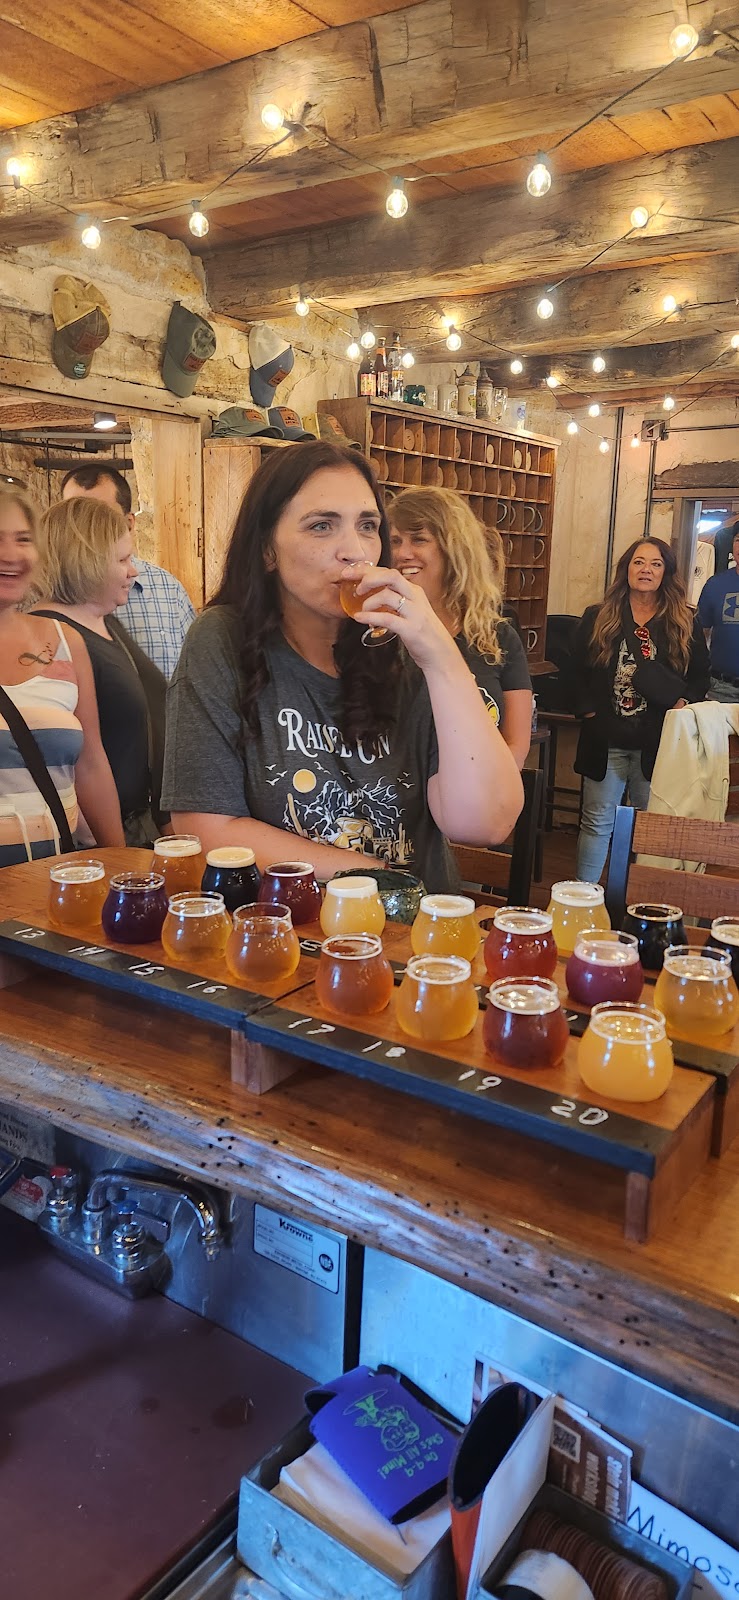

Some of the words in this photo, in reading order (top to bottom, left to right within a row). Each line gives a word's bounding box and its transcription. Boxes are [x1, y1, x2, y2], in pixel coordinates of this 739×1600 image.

[14, 927, 46, 939] 13
[68, 946, 106, 957] 14
[127, 961, 165, 976] 15
[186, 980, 228, 994] 16
[288, 1017, 336, 1035] 17
[361, 1040, 406, 1058] 18
[458, 1069, 503, 1092] 19
[551, 1099, 609, 1126] 20
[377, 1454, 407, 1480] Mine!
[405, 1445, 421, 1460] All
